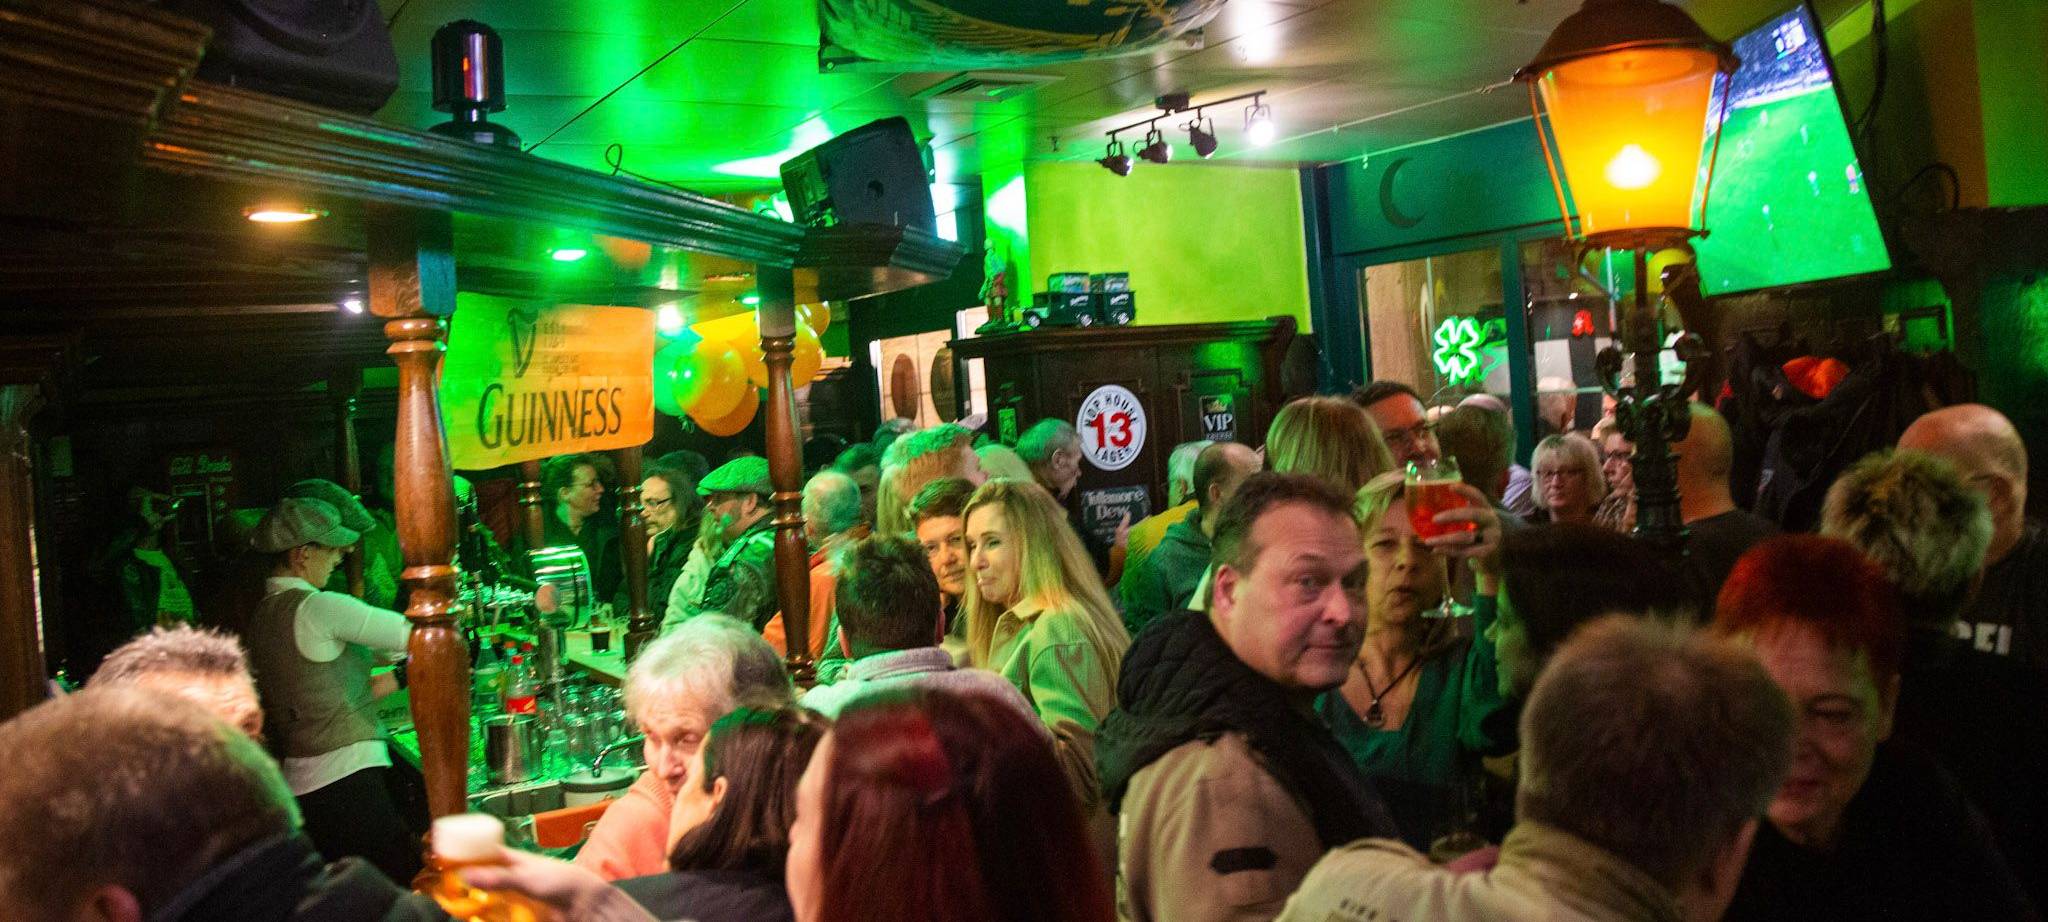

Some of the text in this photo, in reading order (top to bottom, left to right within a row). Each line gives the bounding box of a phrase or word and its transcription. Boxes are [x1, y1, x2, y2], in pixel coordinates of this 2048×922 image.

[478, 383, 622, 450] GUINNESS
[1084, 393, 1140, 427] HOP HOUSE
[1203, 413, 1233, 432] VIP
[1090, 410, 1133, 449] 13
[1094, 447, 1133, 463] LAGER
